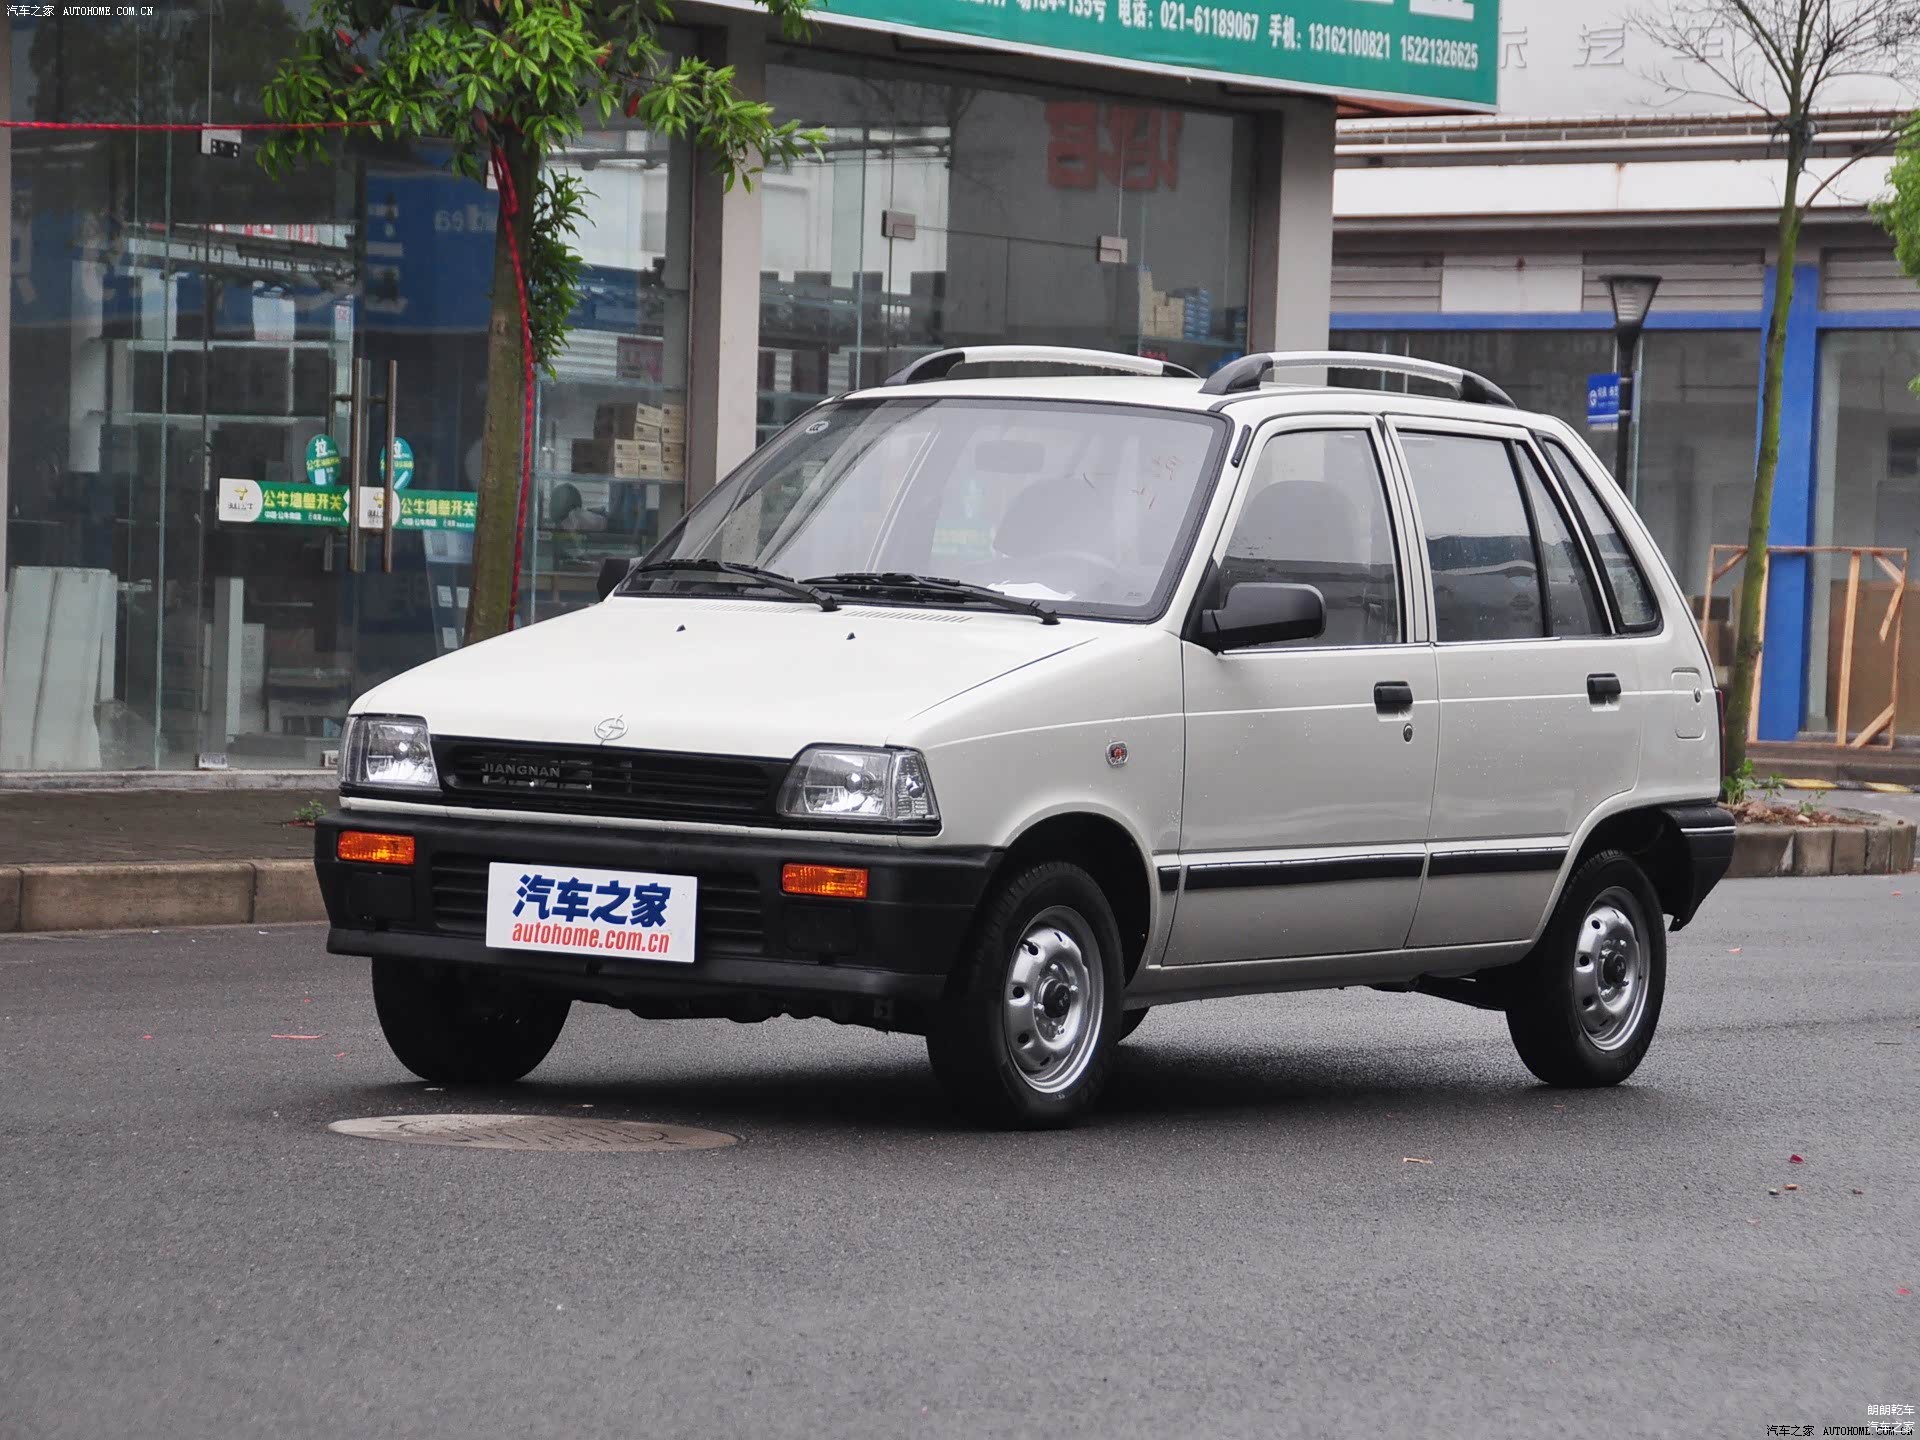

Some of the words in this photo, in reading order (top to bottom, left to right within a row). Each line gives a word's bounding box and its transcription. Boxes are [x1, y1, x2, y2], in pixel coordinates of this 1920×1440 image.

[1160, 0, 1260, 42] 021-61189067
[1308, 22, 1391, 60] 13162100821
[1400, 34, 1478, 70] 15221326625
[480, 763, 561, 778] JIANGNAN
[512, 873, 672, 928] 汽车之家
[511, 921, 671, 954] autohome.com.cn
